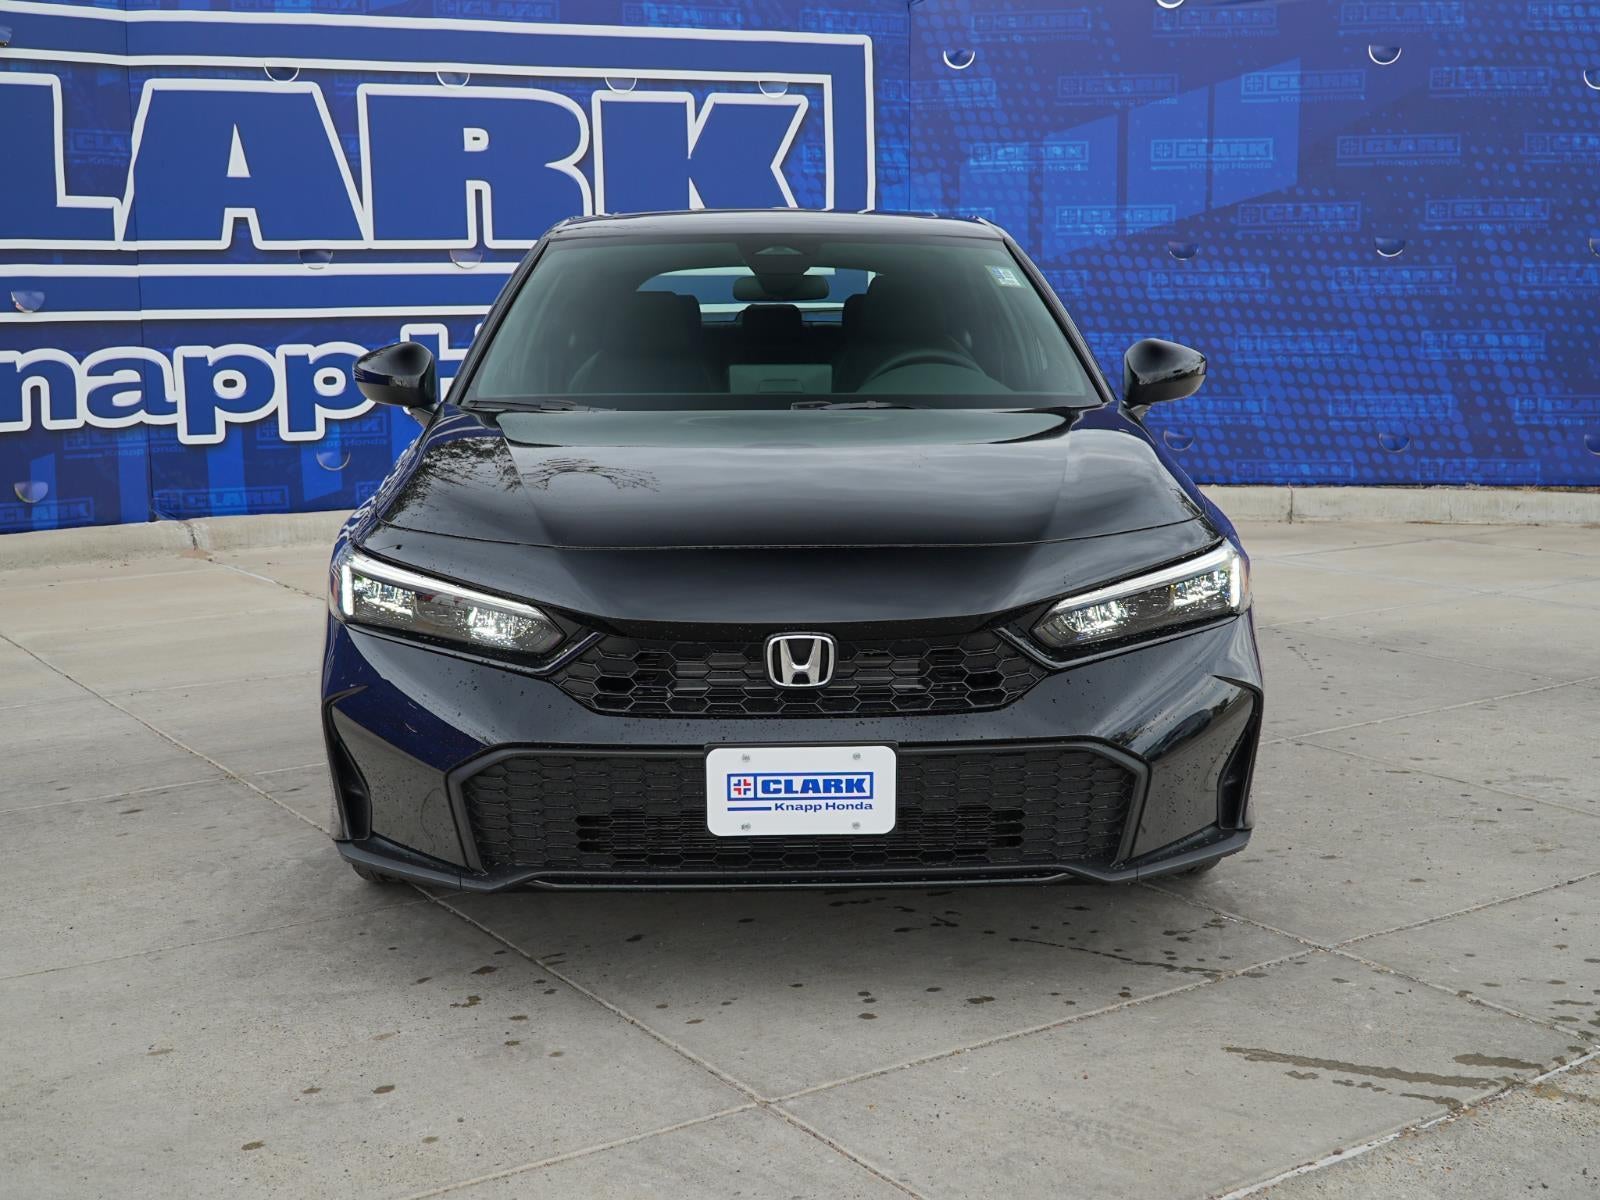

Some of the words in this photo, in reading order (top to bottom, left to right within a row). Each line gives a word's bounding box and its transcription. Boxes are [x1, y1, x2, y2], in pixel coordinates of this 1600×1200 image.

[1178, 142, 1267, 158] CLARK
[760, 777, 867, 796] CLARK
[773, 802, 823, 813] Knapp
[825, 801, 873, 811] Honda
